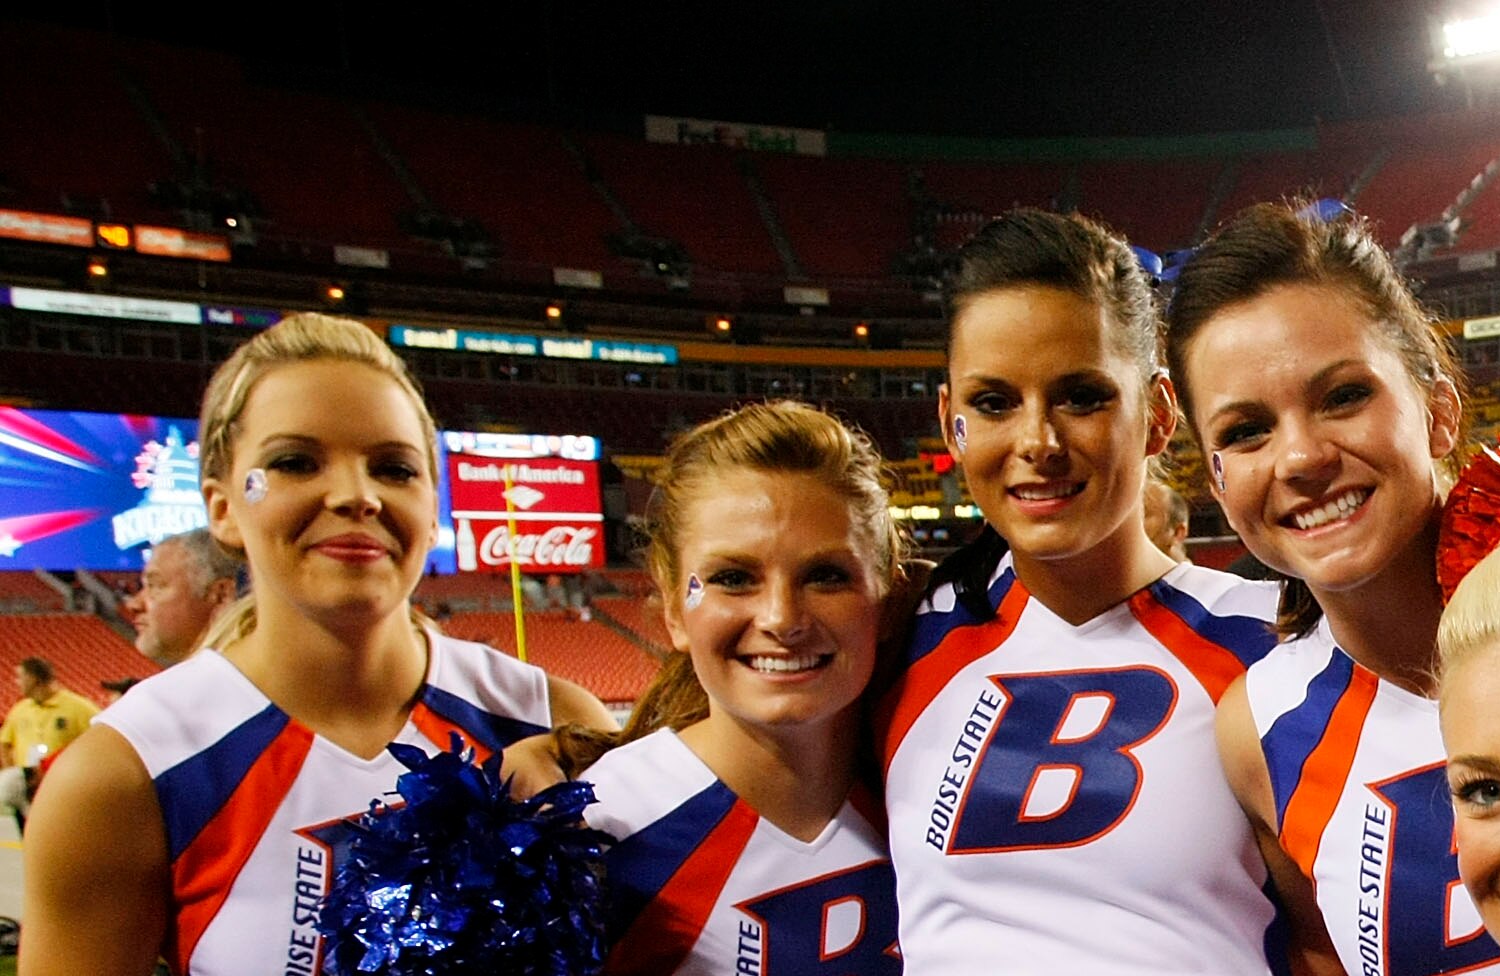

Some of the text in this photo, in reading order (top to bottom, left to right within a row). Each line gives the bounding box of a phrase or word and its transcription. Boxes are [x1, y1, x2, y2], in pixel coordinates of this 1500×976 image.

[458, 462, 499, 482] Bank
[519, 464, 585, 485] America
[925, 690, 1002, 851] BOISE STATE
[945, 663, 1180, 856] B
[293, 847, 323, 930] STATE
[1359, 803, 1386, 899] STATE
